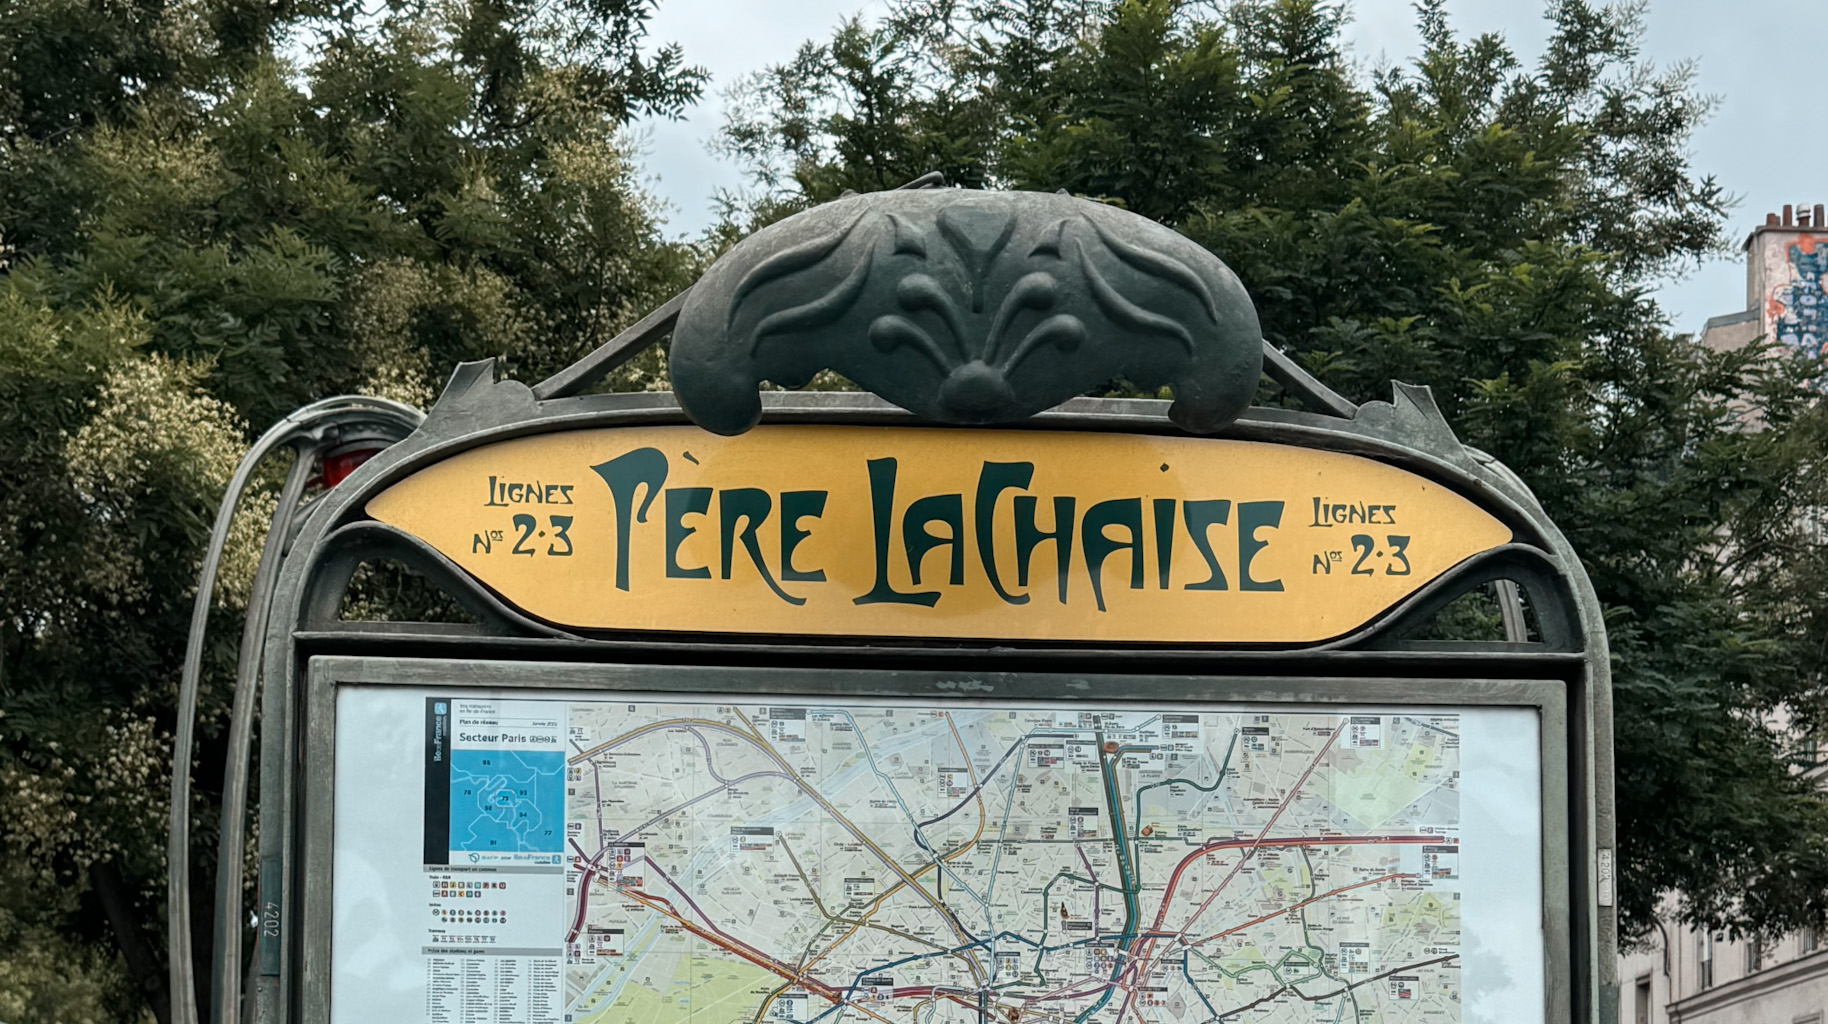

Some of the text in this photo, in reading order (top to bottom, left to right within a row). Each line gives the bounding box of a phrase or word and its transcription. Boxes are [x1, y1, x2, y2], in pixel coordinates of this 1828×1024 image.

[590, 446, 829, 606] PÈRE
[460, 733, 526, 743] Secteur Paris
[263, 901, 280, 938] 4202
